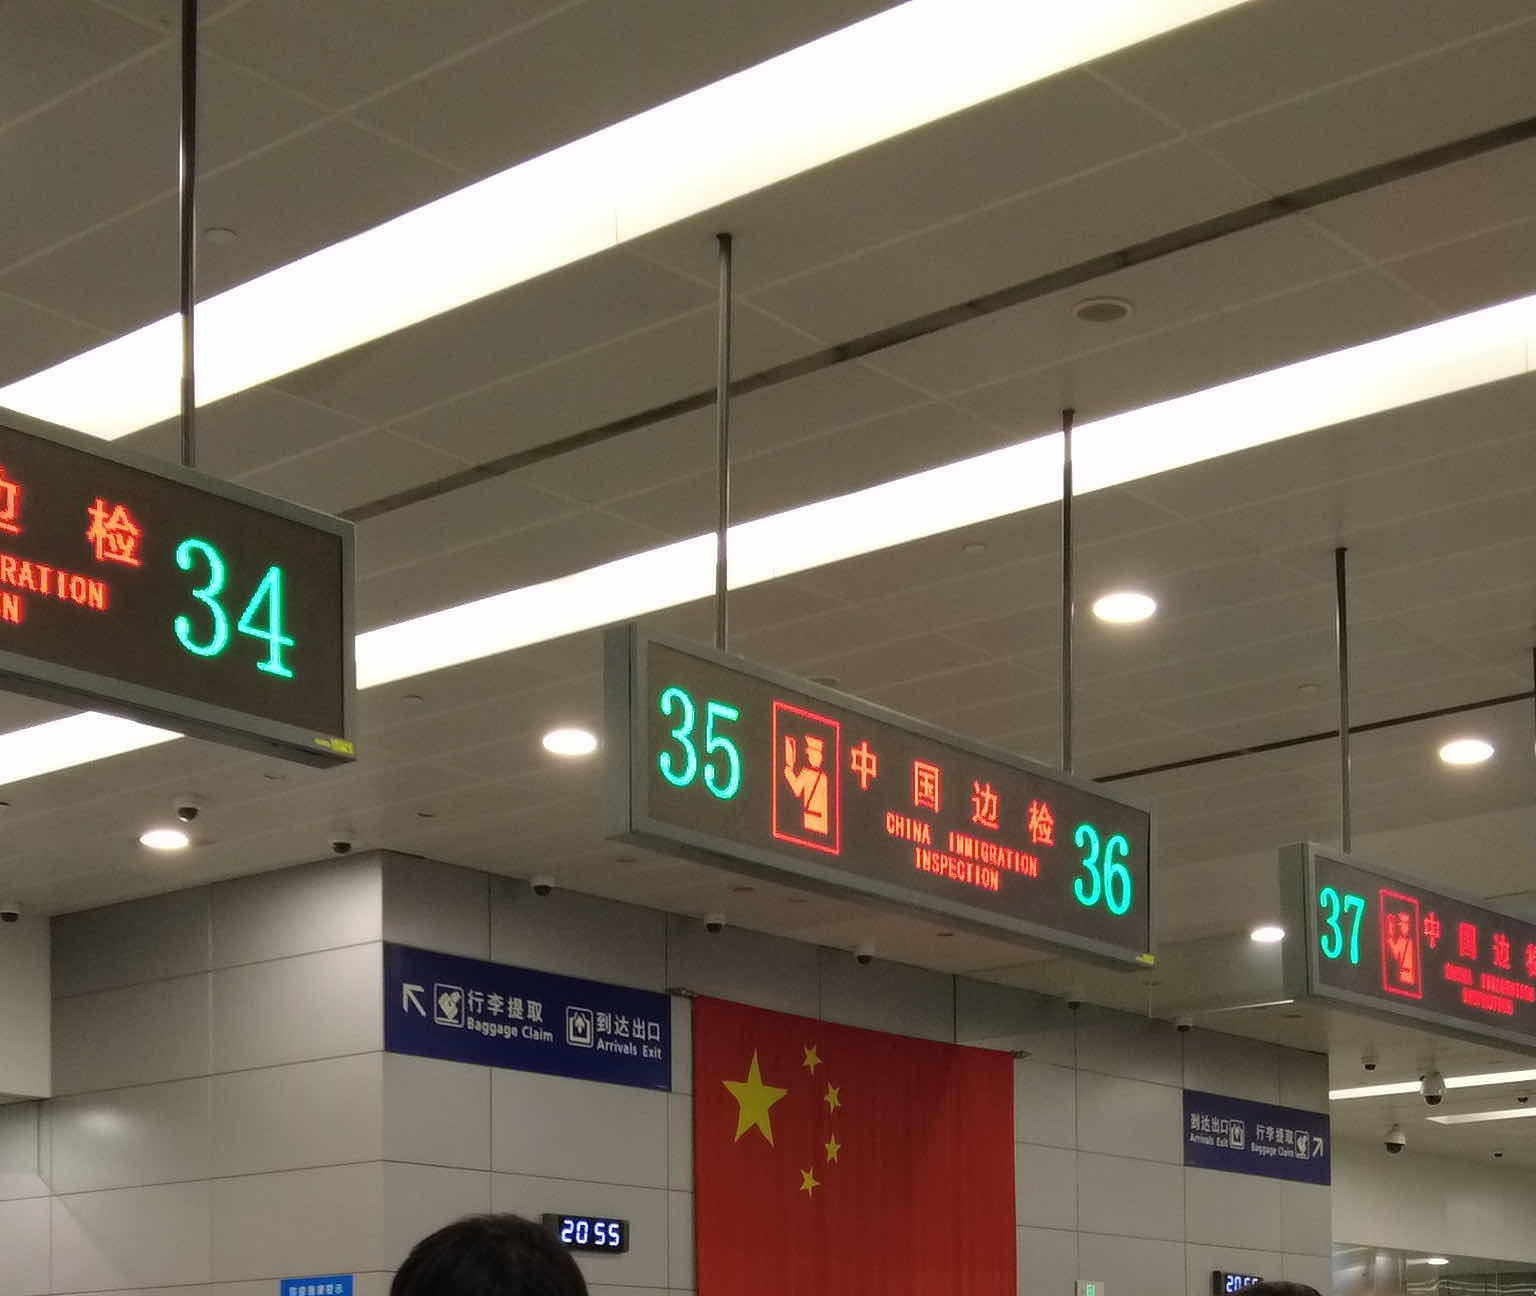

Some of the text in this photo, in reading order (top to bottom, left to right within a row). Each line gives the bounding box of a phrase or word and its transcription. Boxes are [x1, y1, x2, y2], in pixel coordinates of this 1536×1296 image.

[174, 537, 296, 679] 34
[659, 687, 742, 801] 35
[850, 741, 1056, 847] 中国边检
[885, 812, 1040, 878] CHINA IMMIGRATION
[914, 848, 1000, 892] INSPECTION
[1073, 824, 1132, 917] 36
[1320, 887, 1366, 966] 37
[466, 1017, 663, 1060] Baggage Claim Arrivals Exit
[467, 989, 660, 1041] 行李提取 到达出口
[1190, 1113, 1295, 1145] 到达出口 行李提取
